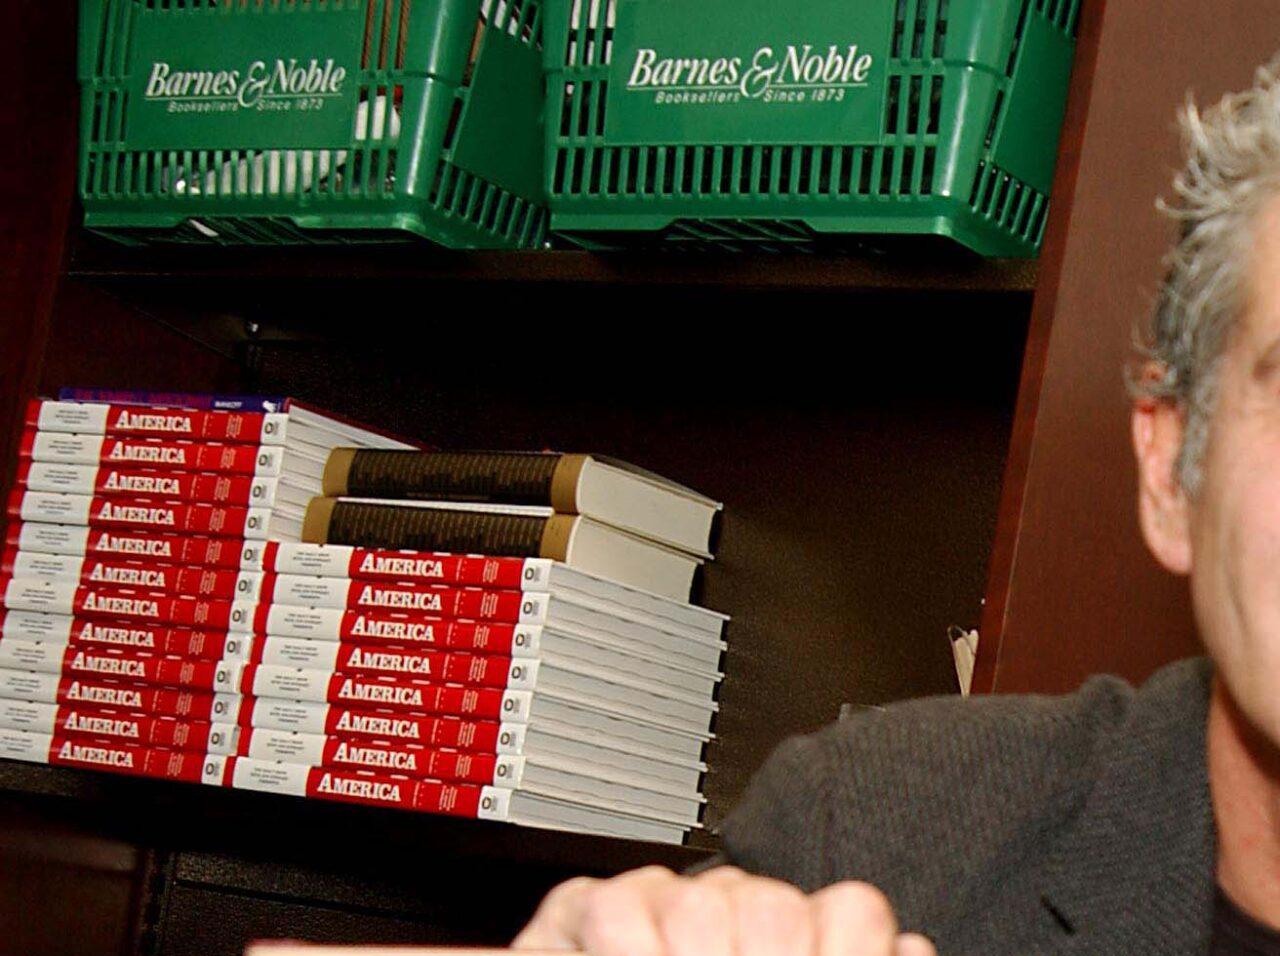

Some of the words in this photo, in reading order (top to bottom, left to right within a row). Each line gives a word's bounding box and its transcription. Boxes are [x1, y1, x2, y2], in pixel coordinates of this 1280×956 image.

[146, 61, 240, 98] Barnes
[236, 60, 270, 107] &
[268, 58, 346, 95] Noble
[627, 47, 741, 88] Barnes
[739, 46, 778, 99] &
[775, 44, 872, 85] Noble
[655, 90, 740, 105] Booksellers
[763, 88, 805, 102] Since
[811, 88, 844, 102] 1873
[115, 409, 191, 433] AMERICA
[110, 440, 186, 464] AMERICA
[104, 471, 180, 494] AMERICA
[98, 501, 174, 525] AMERICA
[95, 532, 172, 557] AMERICA
[89, 562, 165, 587] AMERICA
[359, 552, 444, 578] AMERICA
[83, 591, 159, 617] AMERICA
[357, 585, 442, 611] AMERICA
[79, 622, 154, 647] AMERICA
[350, 615, 434, 642] AMERICA
[71, 651, 145, 676] AMERICA
[347, 647, 431, 674] AMERICA
[66, 681, 142, 708] AMERICA
[338, 678, 423, 705] AMERICA
[64, 711, 139, 738] AMERICA
[336, 710, 420, 738] AMERICA
[58, 741, 133, 767] AMERICA
[333, 742, 417, 770] AMERICA
[317, 772, 401, 801] AMERICA
